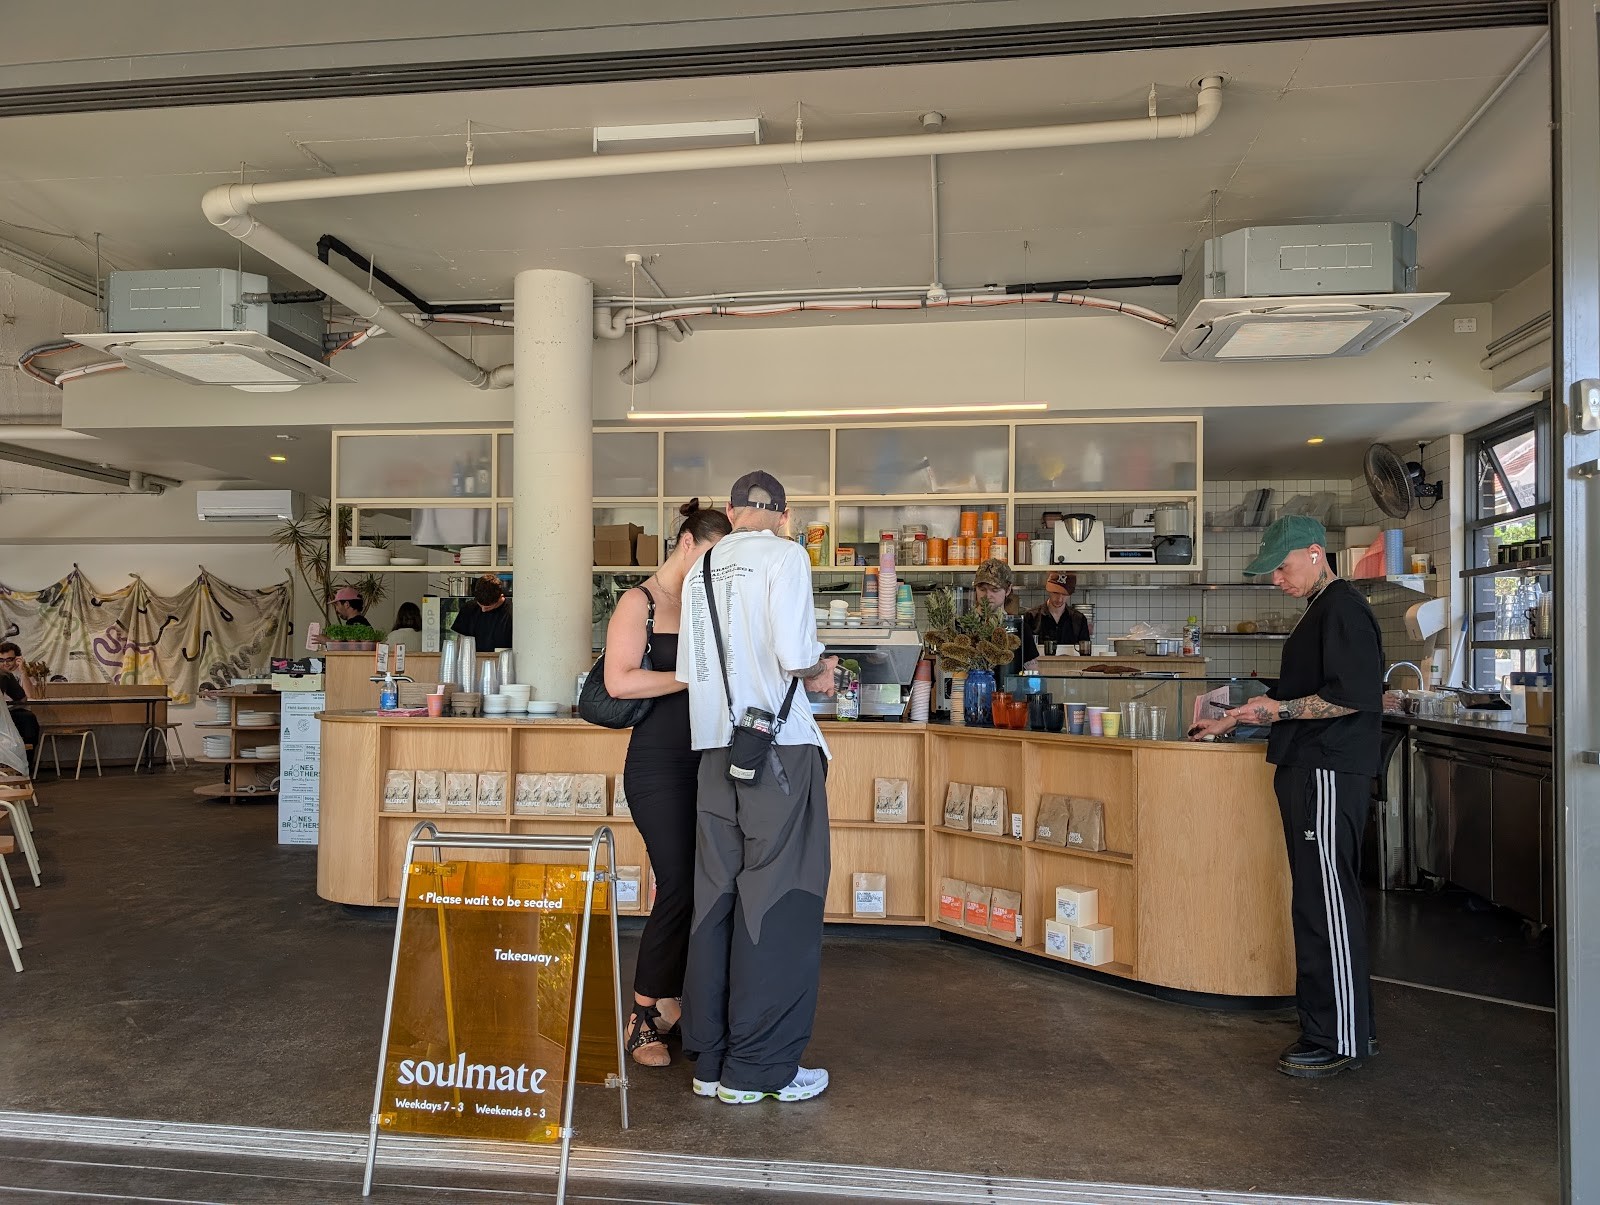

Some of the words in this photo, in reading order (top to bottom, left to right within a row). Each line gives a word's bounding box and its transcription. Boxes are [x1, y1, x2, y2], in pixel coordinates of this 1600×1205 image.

[425, 891, 462, 905] Please
[464, 894, 489, 906] wait
[491, 895, 505, 907] to
[506, 895, 522, 908] be
[523, 894, 563, 911] seated
[494, 948, 552, 966] Takeaway
[397, 1052, 548, 1094] soulmate
[395, 1097, 442, 1113] Weekdays
[443, 1101, 450, 1112] 7
[457, 1101, 464, 1113] 3
[475, 1103, 523, 1117] Weekends
[524, 1107, 532, 1118] 8
[538, 1107, 546, 1119] 3
